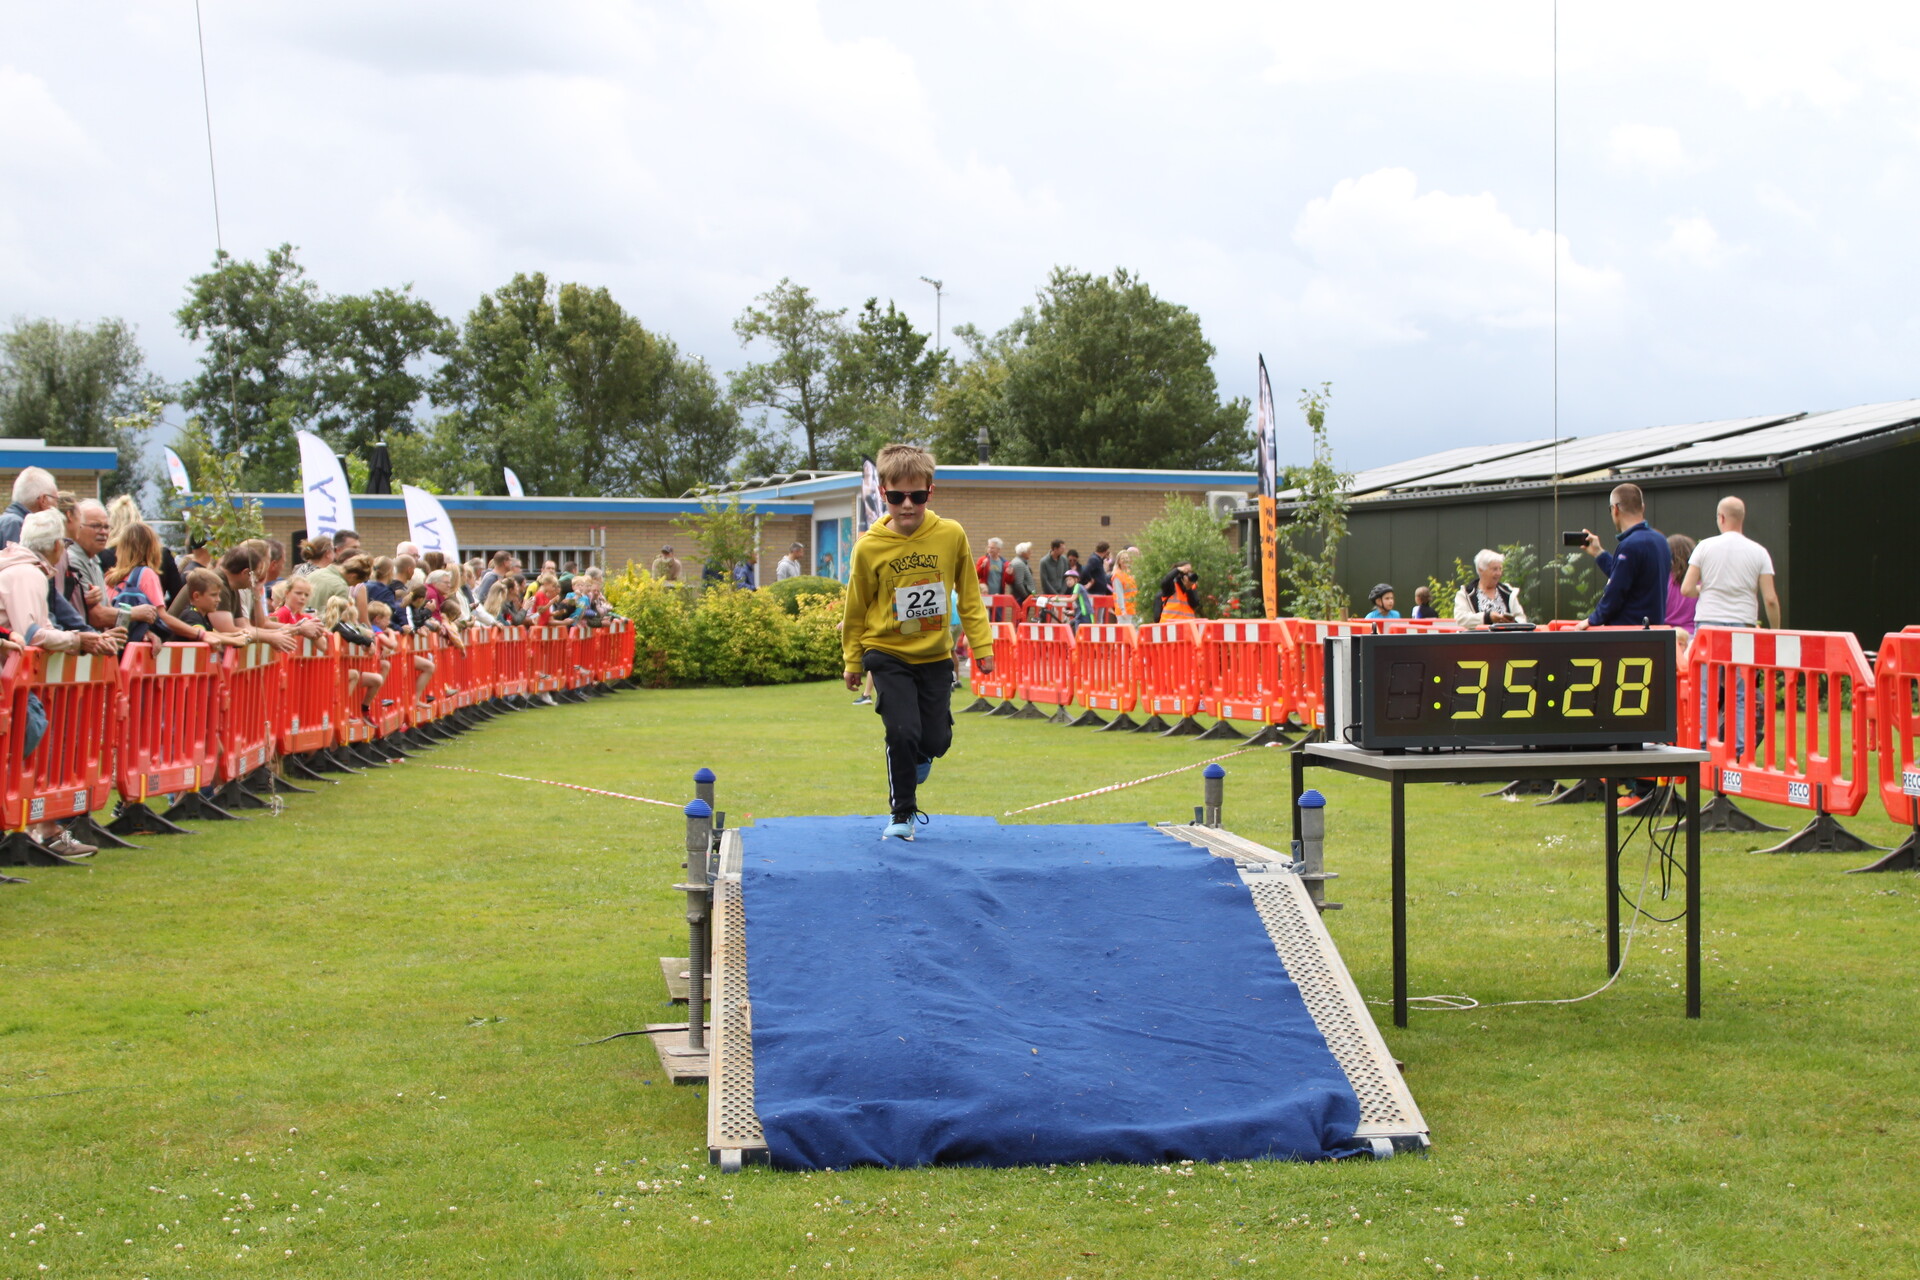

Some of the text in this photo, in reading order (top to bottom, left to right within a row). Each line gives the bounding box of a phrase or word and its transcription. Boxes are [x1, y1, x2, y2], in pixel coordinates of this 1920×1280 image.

[907, 590, 937, 609] 22
[906, 607, 940, 619] Oscar
[1723, 771, 1741, 786] RECO
[1788, 782, 1809, 798] RECO
